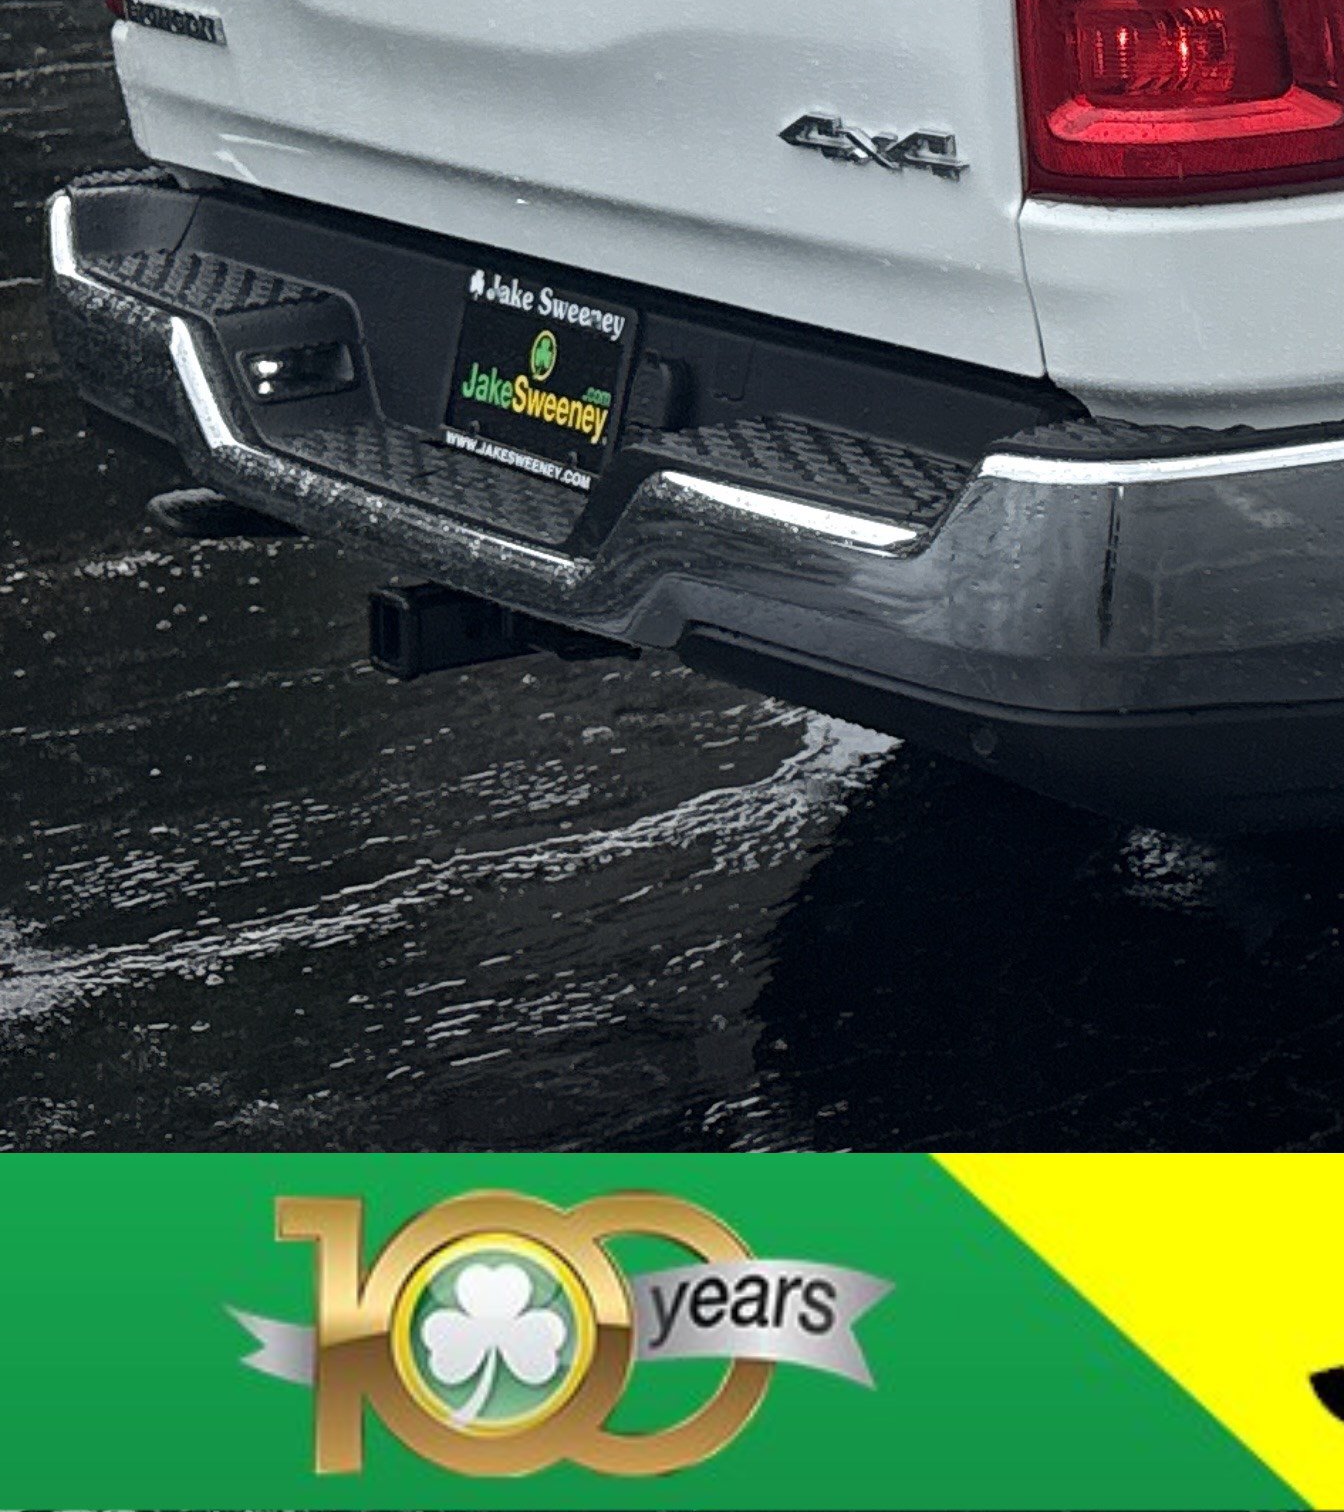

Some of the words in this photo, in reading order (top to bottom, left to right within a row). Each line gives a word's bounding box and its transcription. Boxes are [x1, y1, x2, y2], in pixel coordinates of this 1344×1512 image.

[485, 274, 533, 311] Jake
[539, 287, 625, 341] Sweeney
[446, 431, 591, 490] WWW.JAKESWEENEY.COM
